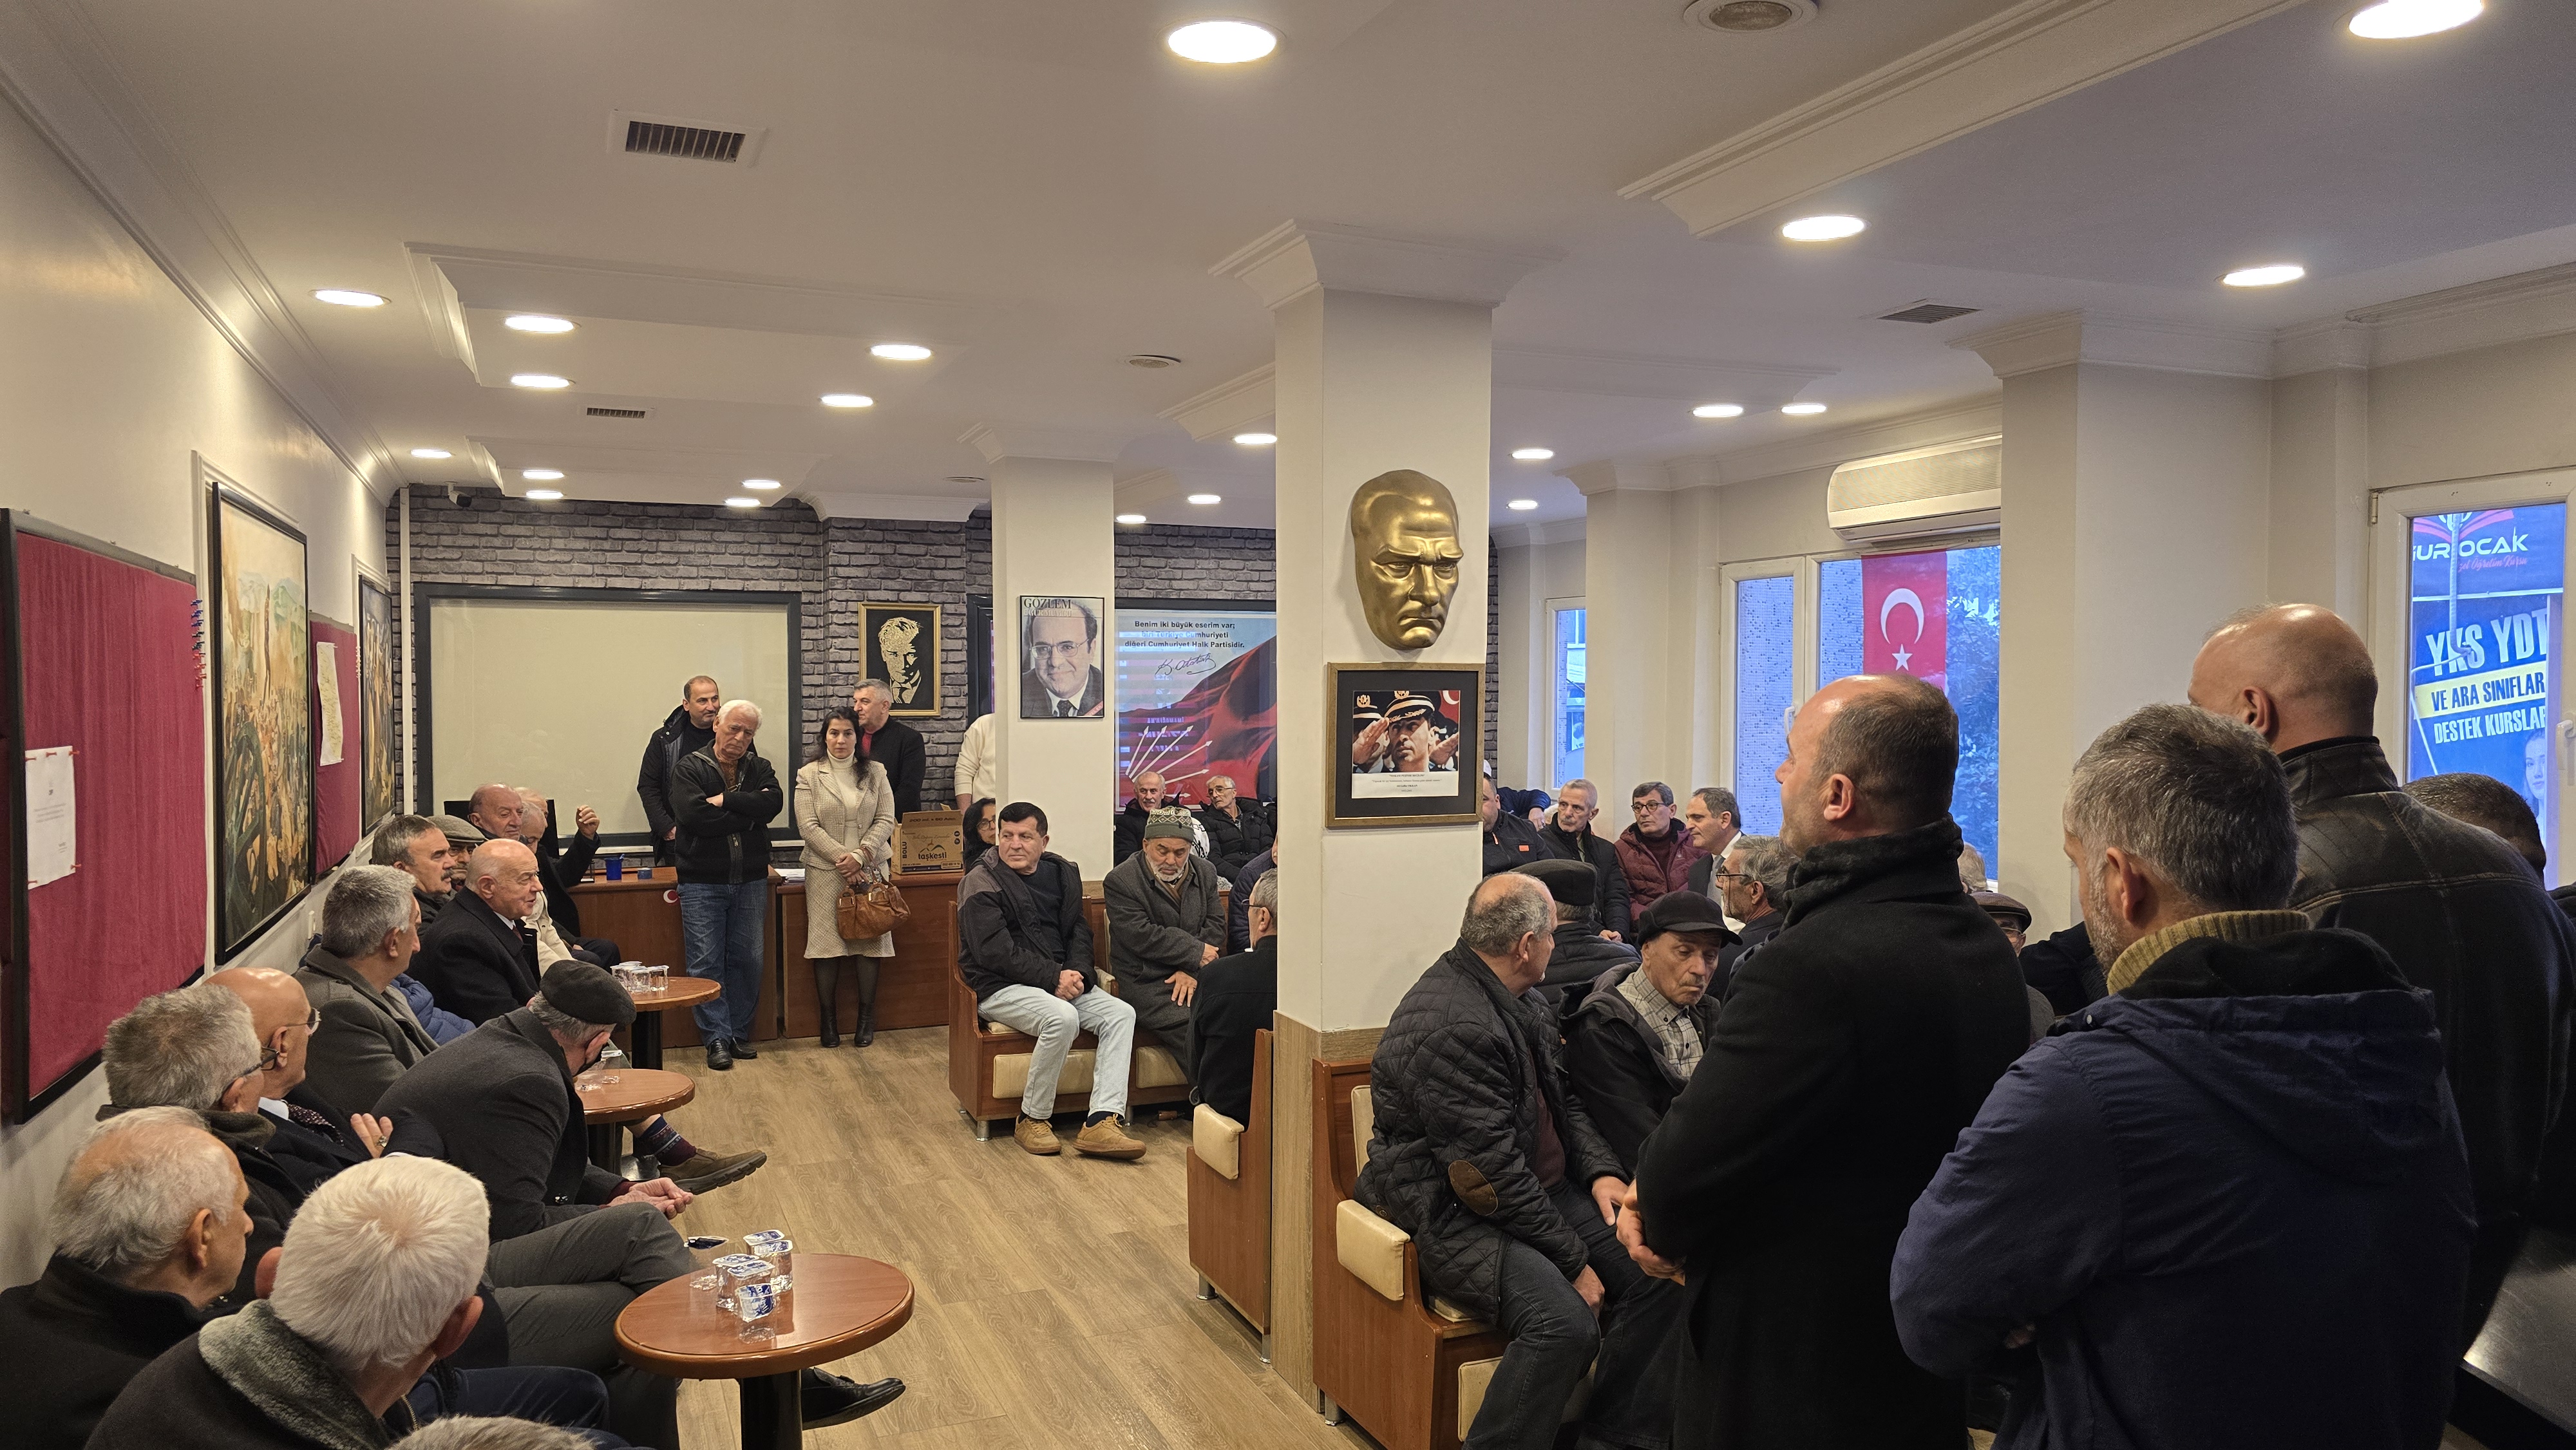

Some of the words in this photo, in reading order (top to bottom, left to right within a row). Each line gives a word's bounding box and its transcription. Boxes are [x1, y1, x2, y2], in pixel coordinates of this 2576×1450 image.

[2458, 527, 2529, 557] OCAK
[1148, 641, 1190, 649] Cumhuriyet
[1157, 630, 1184, 639] Türkiye
[2425, 624, 2485, 676] YKS
[2490, 608, 2548, 663] YDT
[2431, 690, 2448, 712] VE
[2452, 684, 2479, 709] ARA
[2483, 672, 2545, 702] SINIFLAR
[2434, 716, 2483, 744] DESTEK
[918, 851, 947, 862] taşkesti
